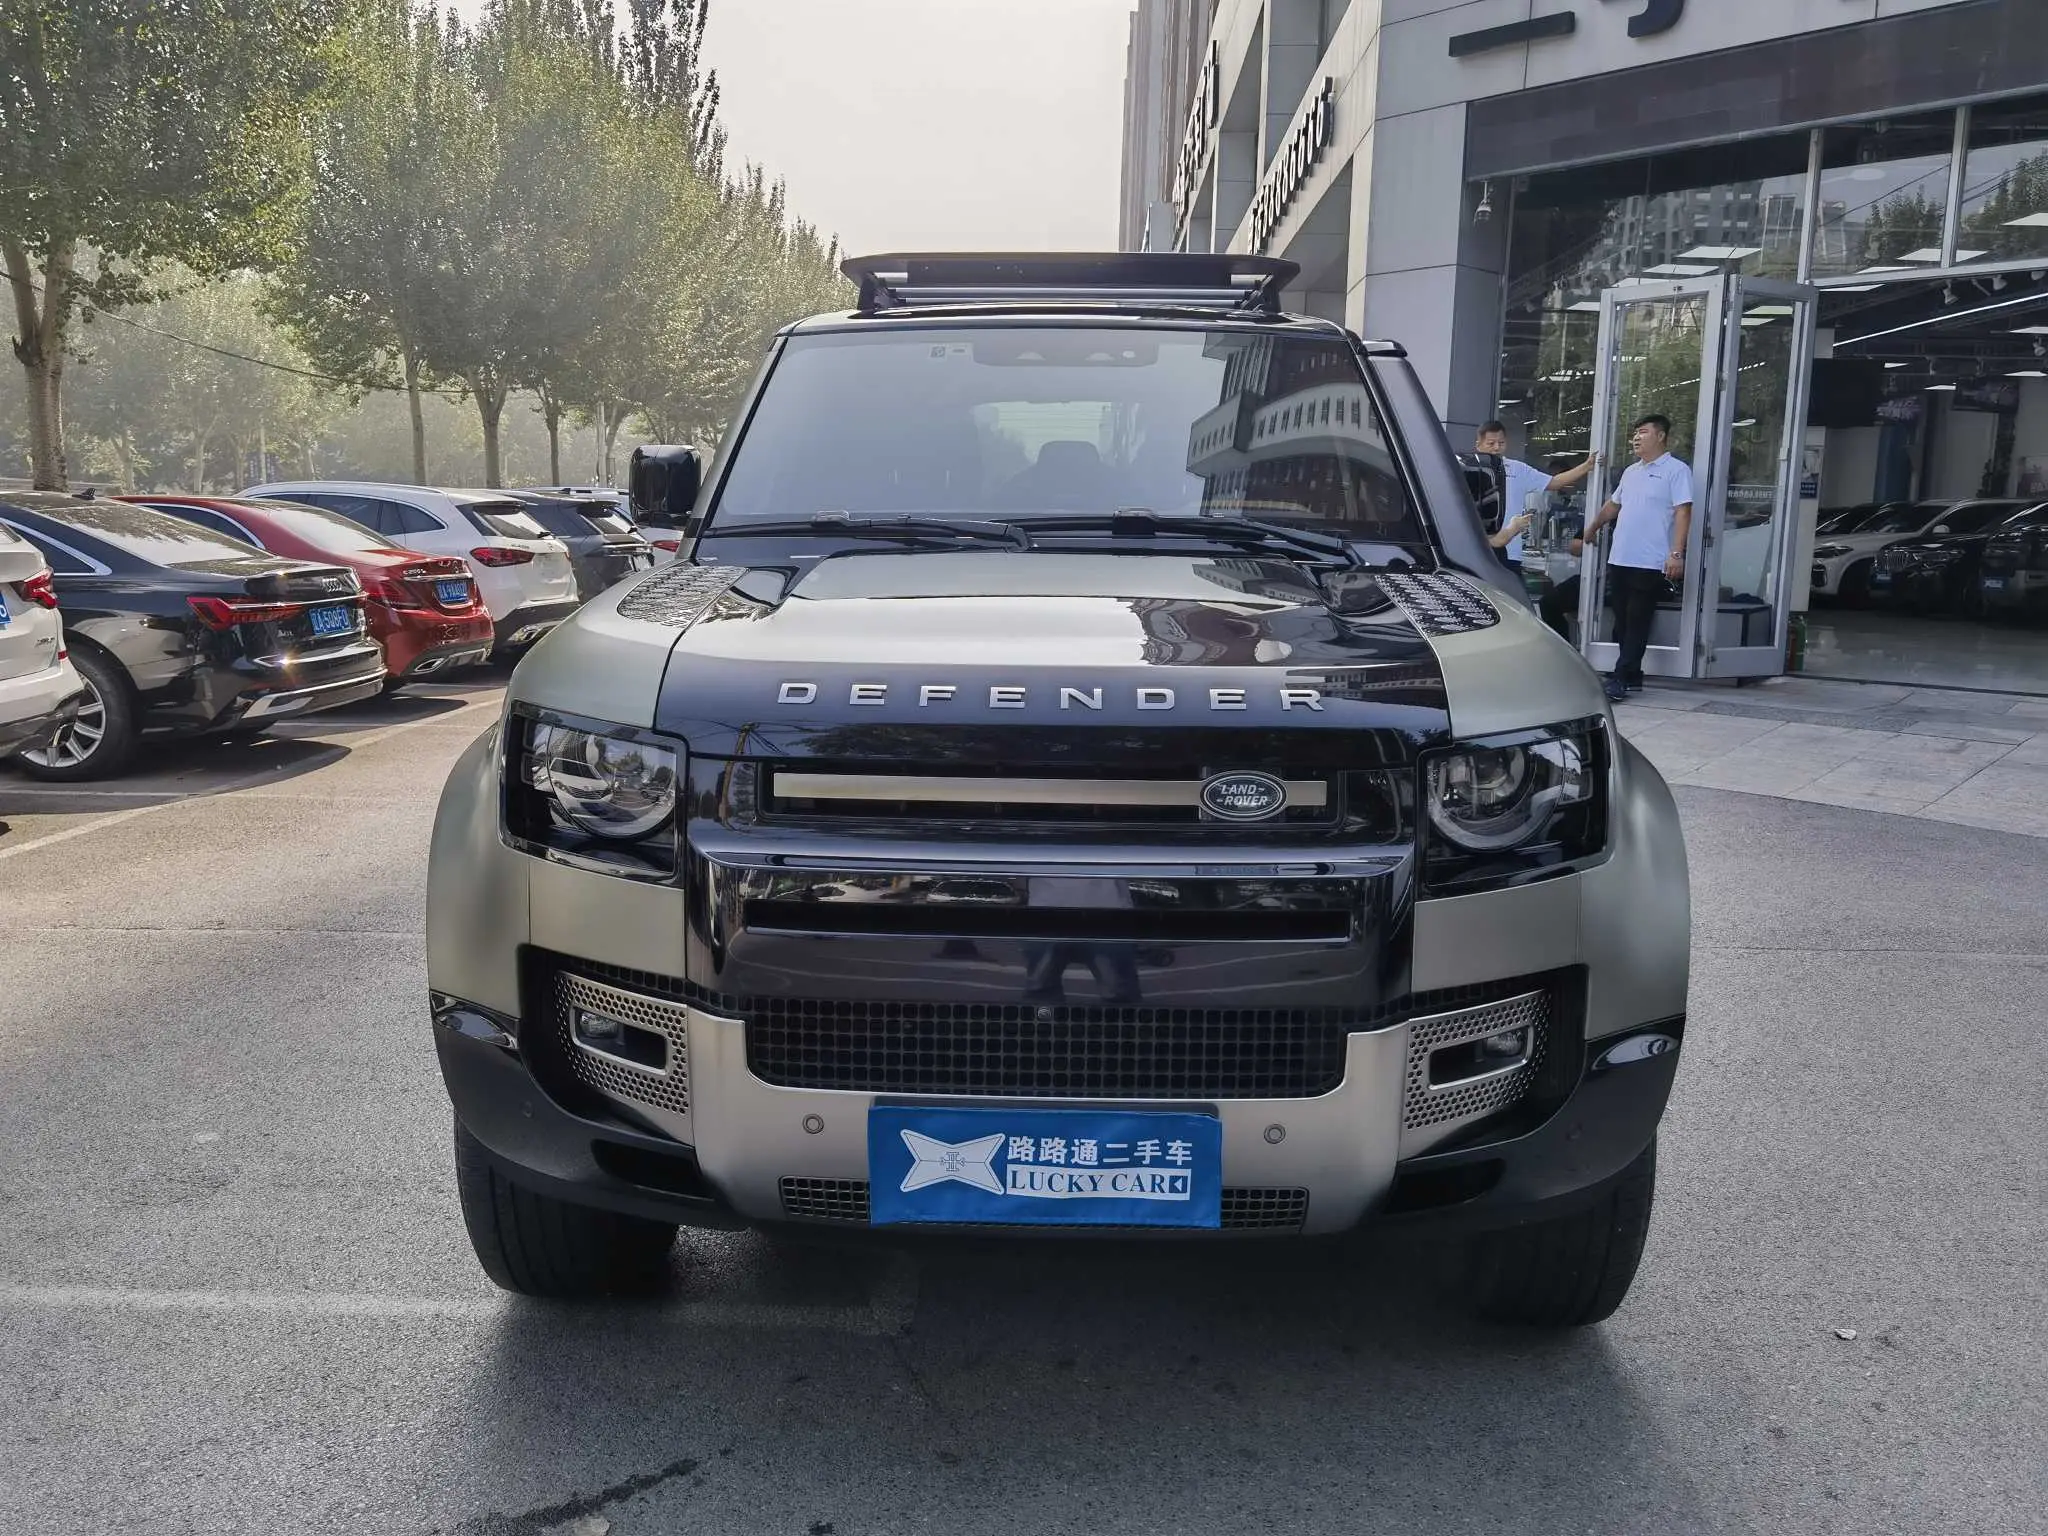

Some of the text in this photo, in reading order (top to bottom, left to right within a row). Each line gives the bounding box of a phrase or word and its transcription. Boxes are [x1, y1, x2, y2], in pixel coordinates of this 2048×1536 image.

[777, 682, 1325, 711] DEFENDER
[1007, 1136, 1193, 1166] 路路通二手车
[1010, 1170, 1165, 1194] LUCKY CAR
